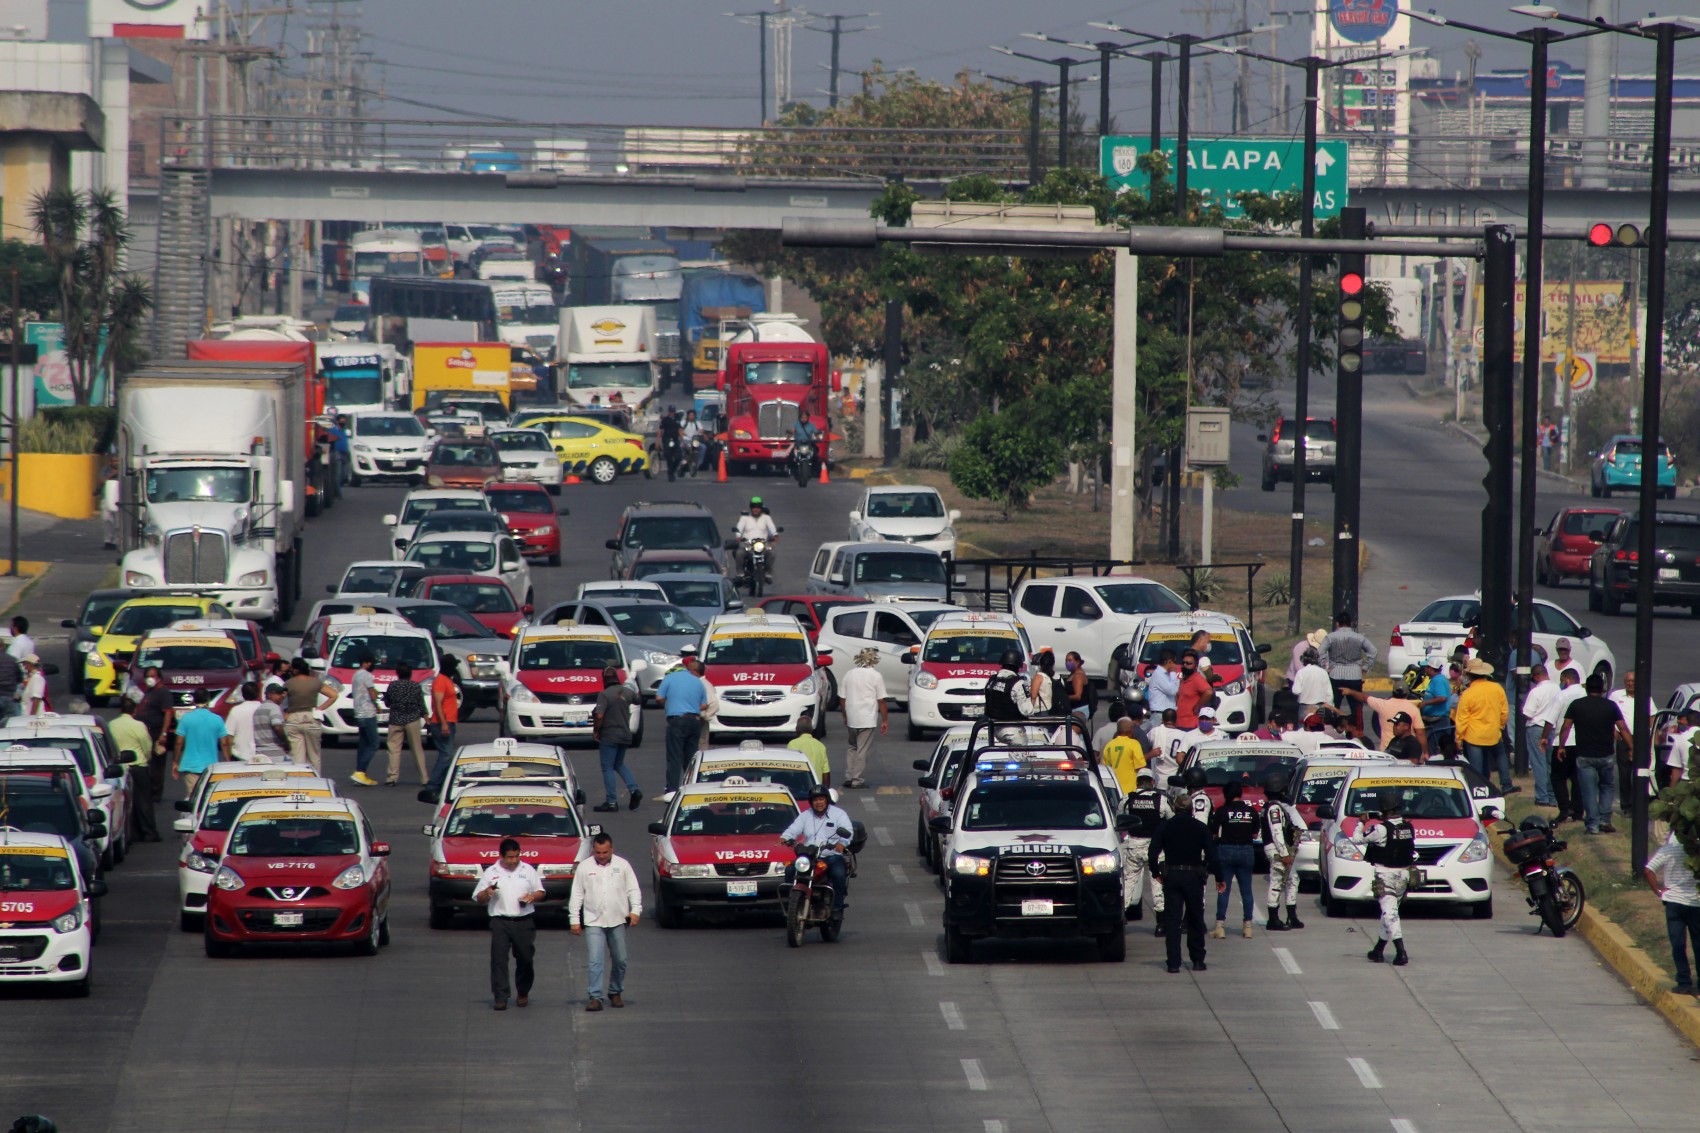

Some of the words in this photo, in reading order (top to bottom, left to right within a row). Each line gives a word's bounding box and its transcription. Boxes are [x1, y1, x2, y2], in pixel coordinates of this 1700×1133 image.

[1118, 158, 1132, 170] 180
[547, 675, 598, 683] VB-5033
[733, 672, 776, 682] VB-2117
[748, 761, 803, 769] VERACRUZ
[1404, 778, 1448, 786] VERACRUZ
[507, 797, 553, 805] VERACRUZ
[715, 849, 770, 860] VB-4837
[998, 845, 1072, 855] POLICIA
[267, 861, 316, 869] VB-7176
[1, 901, 34, 913] 5705
